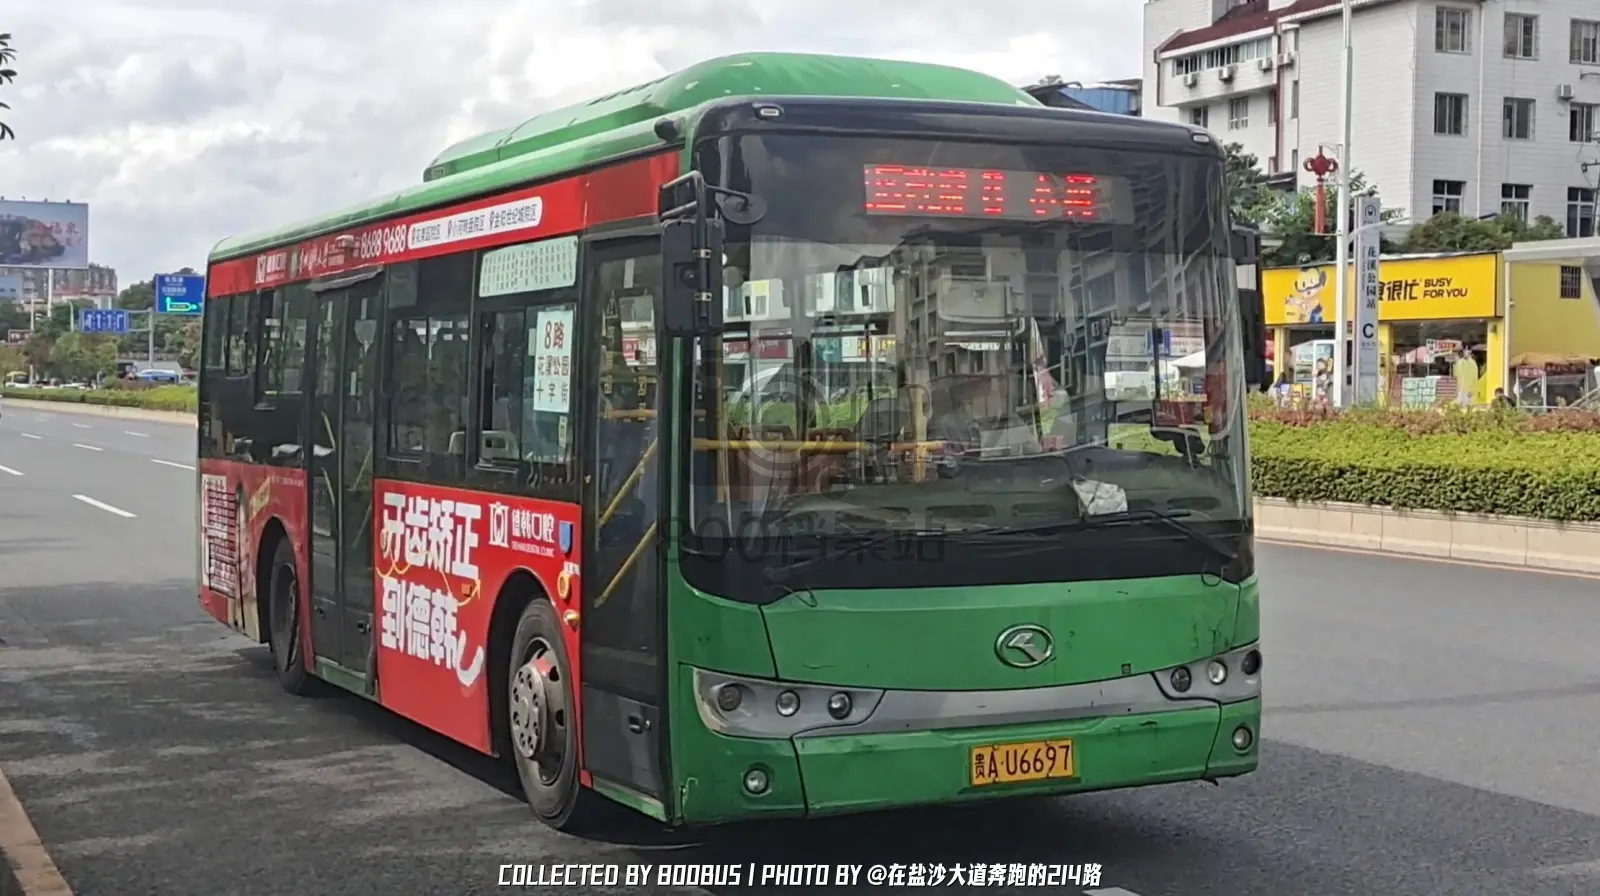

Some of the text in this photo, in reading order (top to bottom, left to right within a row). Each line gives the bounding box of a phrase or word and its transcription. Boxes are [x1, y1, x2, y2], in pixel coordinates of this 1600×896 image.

[1424, 277, 1453, 288] BUSY
[1423, 288, 1468, 299] FOR YOU
[544, 320, 565, 350] 8路
[1362, 323, 1375, 339] C
[382, 491, 482, 581] 牙齿矫正
